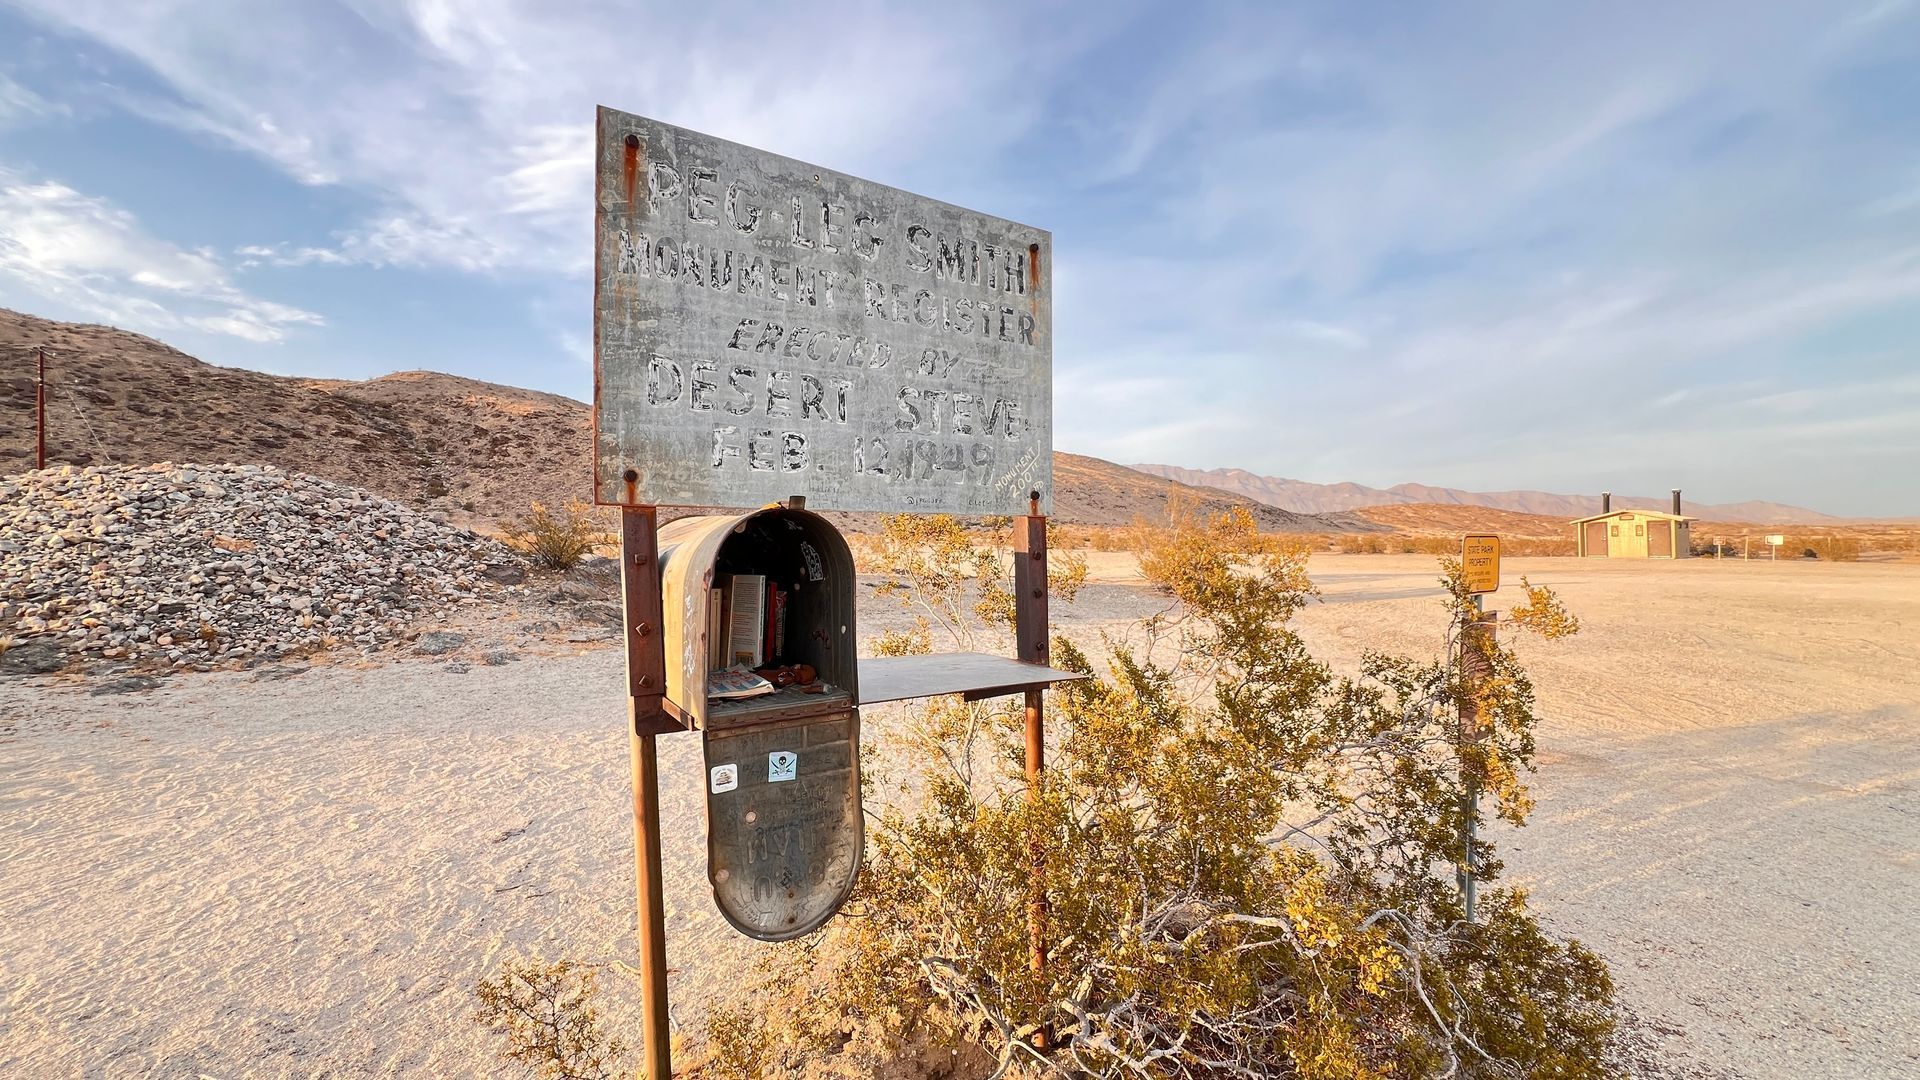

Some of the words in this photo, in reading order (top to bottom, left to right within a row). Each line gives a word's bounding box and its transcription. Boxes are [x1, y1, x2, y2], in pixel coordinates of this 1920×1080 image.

[647, 161, 885, 263] PEG-LEG
[905, 223, 1026, 296] SMITH
[617, 229, 839, 310] MONUMENT
[864, 276, 1036, 346] REGISTER
[727, 317, 892, 369] ERECTED
[916, 347, 962, 379] BY
[647, 352, 853, 424] DESERT
[895, 384, 1022, 443] STEVE
[994, 446, 1036, 492] MONUMENT
[1009, 471, 1032, 498] 200
[1468, 545, 1480, 554] STATE
[1481, 545, 1494, 554] PARK
[1469, 557, 1492, 567] PROPERTY
